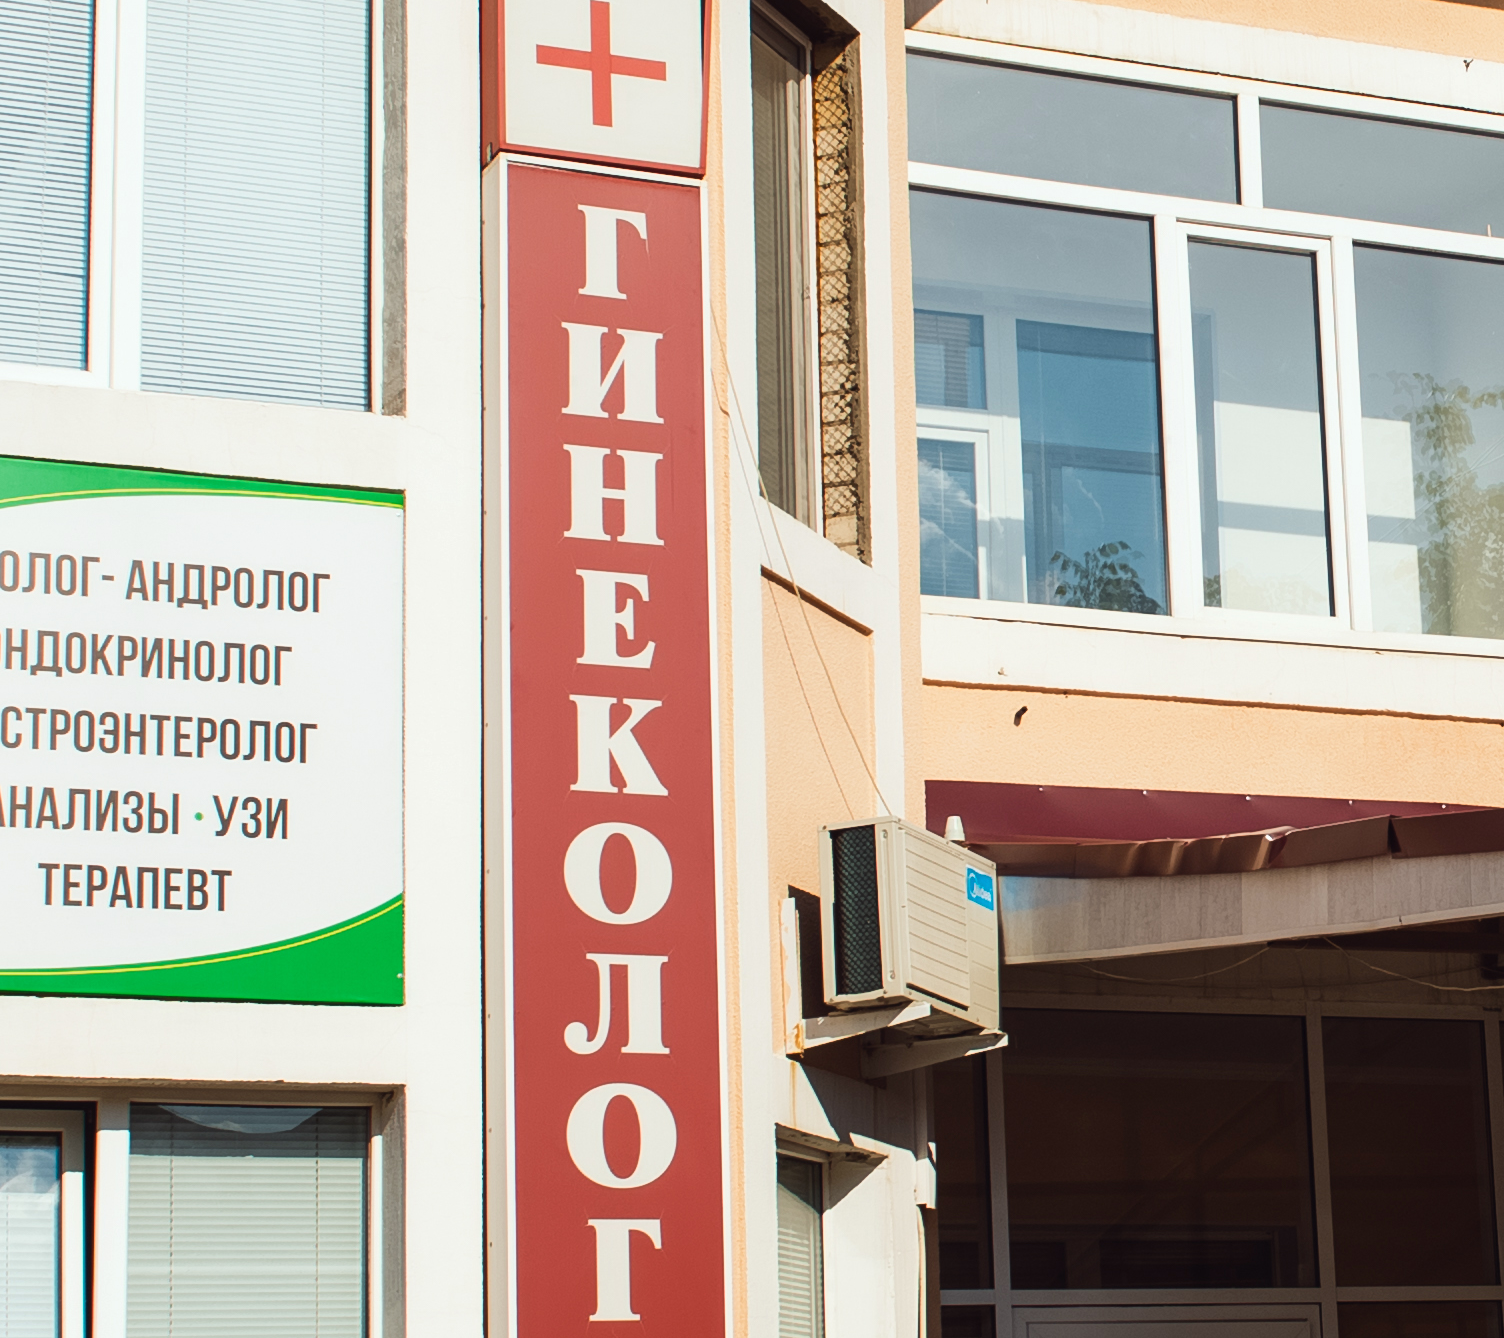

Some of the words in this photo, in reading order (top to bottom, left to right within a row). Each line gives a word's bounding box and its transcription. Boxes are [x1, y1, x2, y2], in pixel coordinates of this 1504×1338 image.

[125, 559, 332, 613] АНДРОЛОГ
[212, 795, 289, 840] УЗИ
[37, 862, 234, 913] ТЕРАПЕВТ
